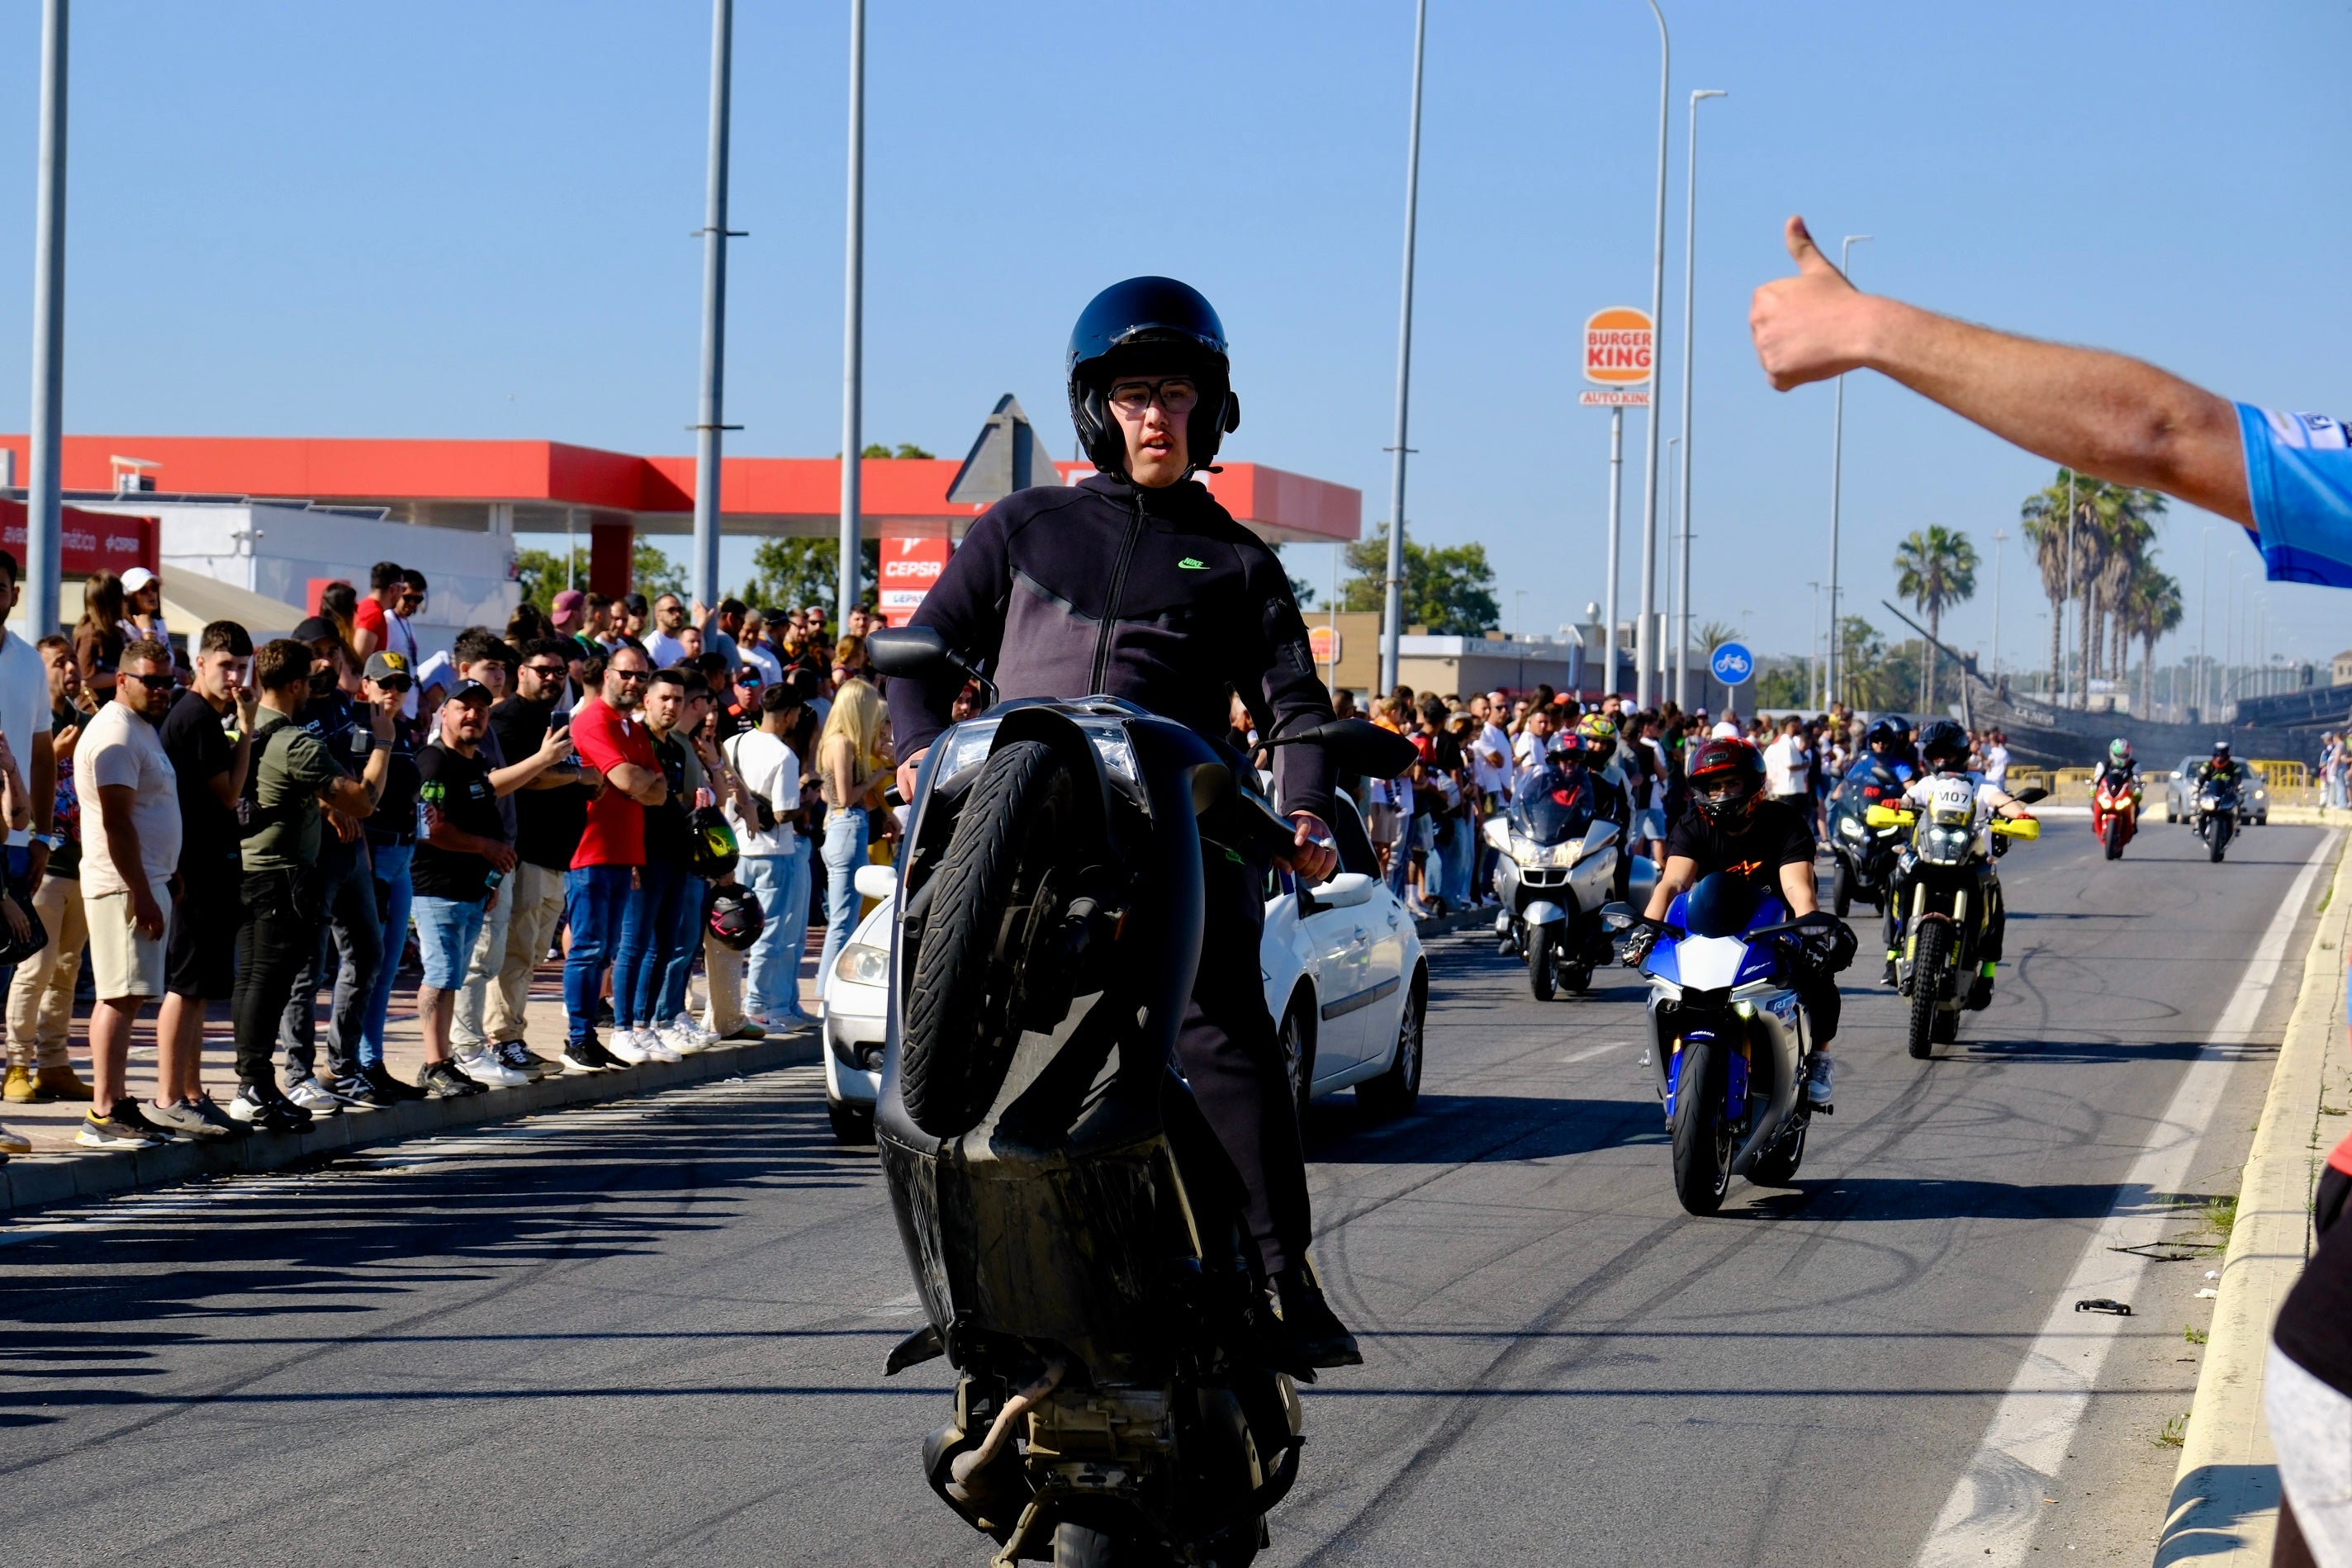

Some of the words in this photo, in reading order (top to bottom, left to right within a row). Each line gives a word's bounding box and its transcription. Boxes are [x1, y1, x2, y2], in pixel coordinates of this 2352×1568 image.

[1588, 332, 1651, 346] BURGER
[1588, 348, 1651, 367] KING
[1583, 392, 1619, 403] AUTO
[885, 561, 941, 577] CEPSA
[1183, 557, 1203, 567] NIKE
